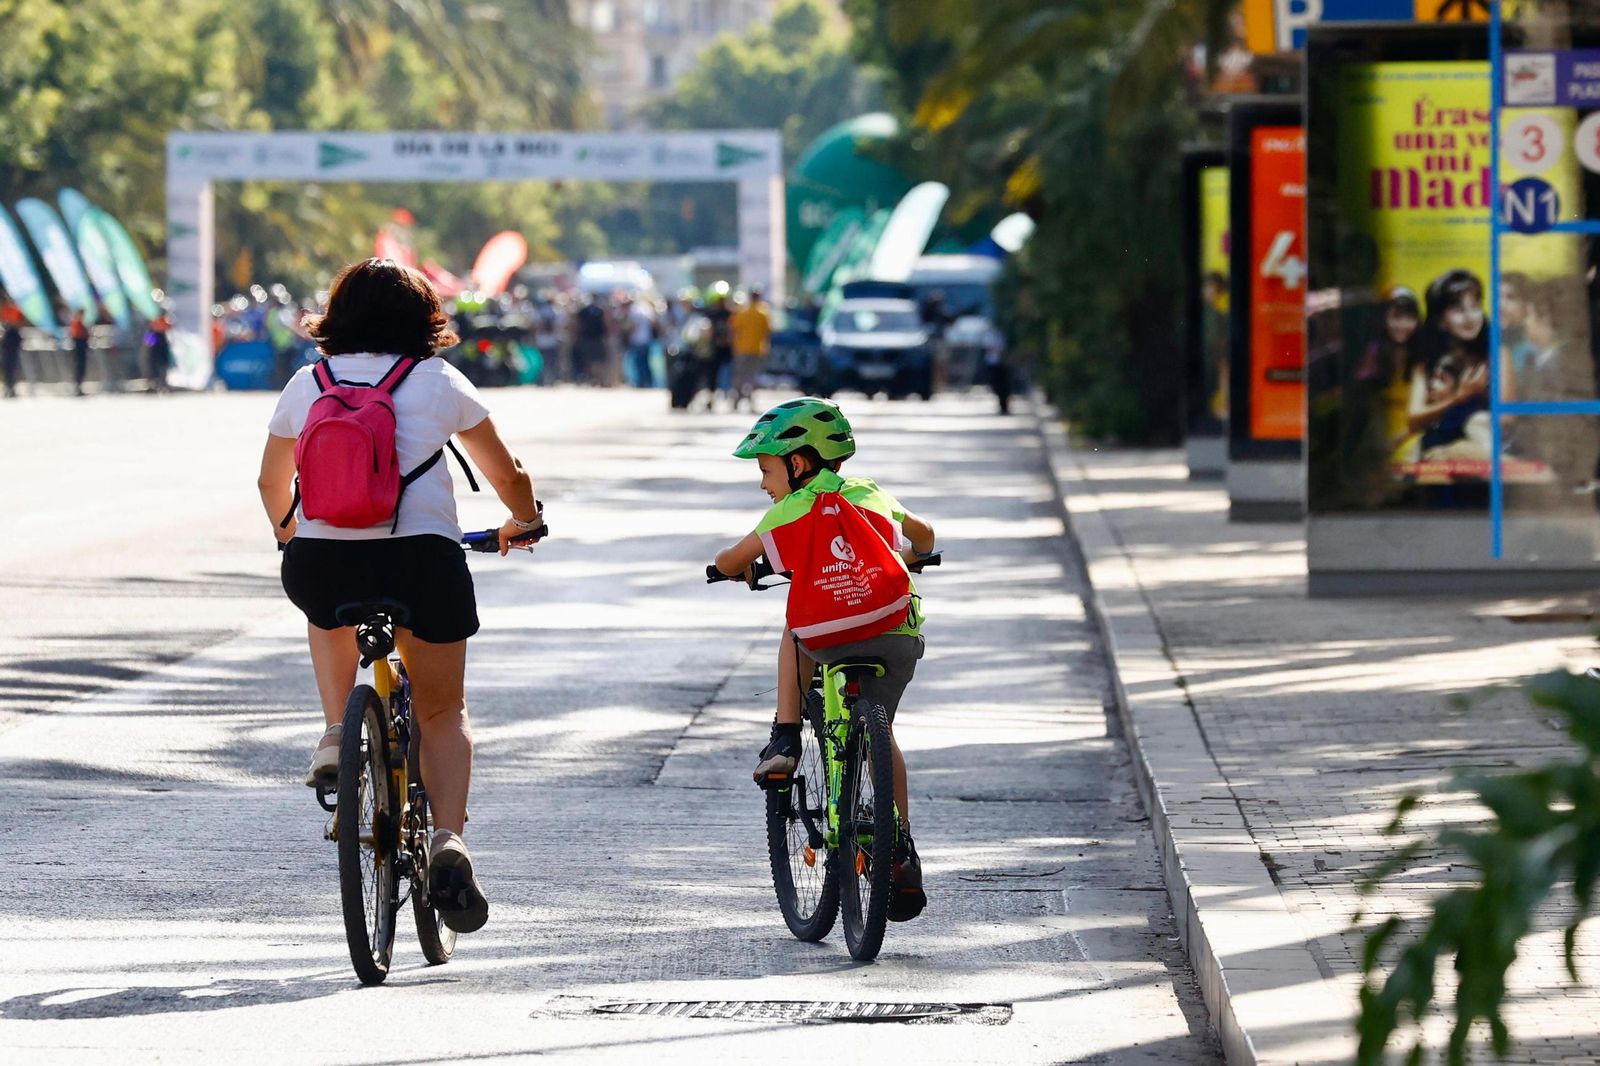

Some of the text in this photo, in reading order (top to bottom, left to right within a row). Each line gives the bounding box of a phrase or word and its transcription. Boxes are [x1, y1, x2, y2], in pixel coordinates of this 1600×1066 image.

[1276, 0, 1323, 51] P
[1522, 125, 1547, 162] 3
[1503, 187, 1558, 225] N1
